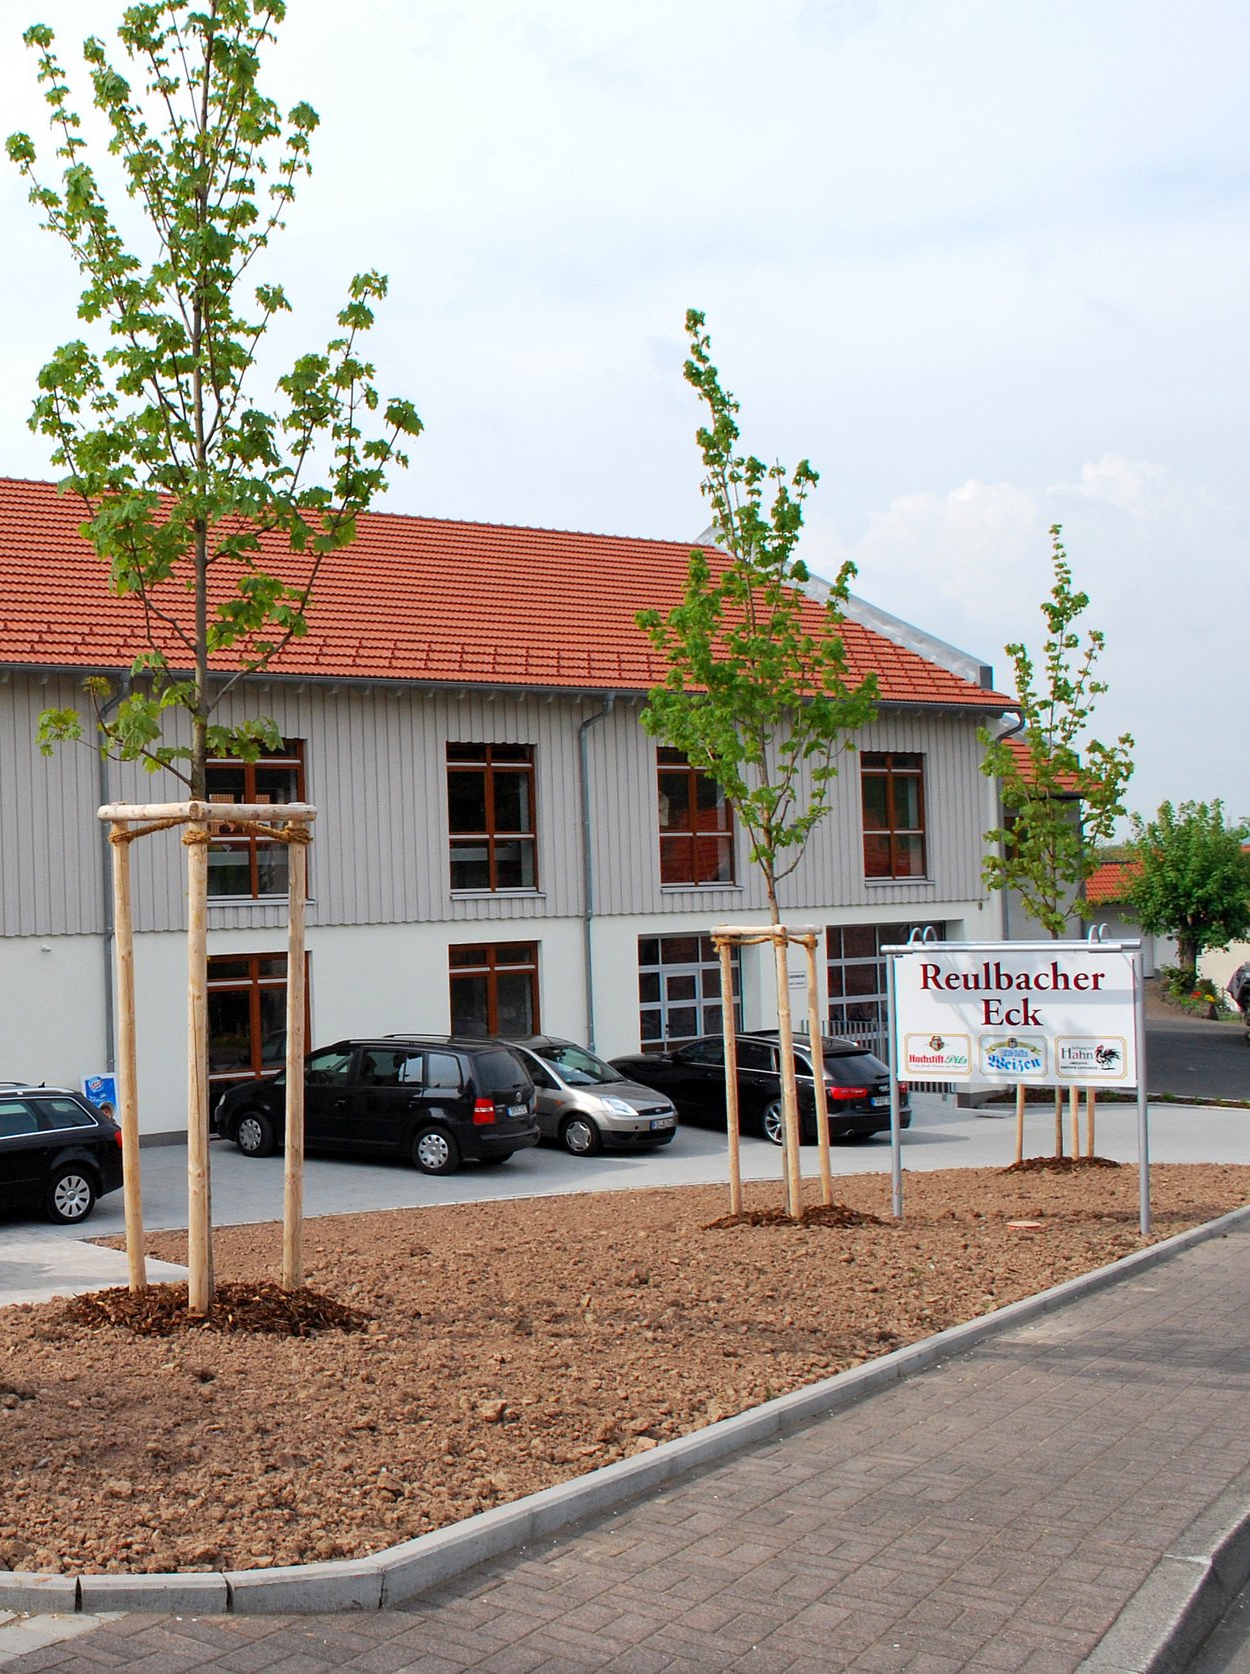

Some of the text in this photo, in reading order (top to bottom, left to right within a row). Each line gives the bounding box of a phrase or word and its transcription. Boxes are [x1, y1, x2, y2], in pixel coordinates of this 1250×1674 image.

[919, 961, 1105, 991] Reulbacher
[981, 997, 1044, 1026] Eck
[1061, 1047, 1094, 1060] Hahn
